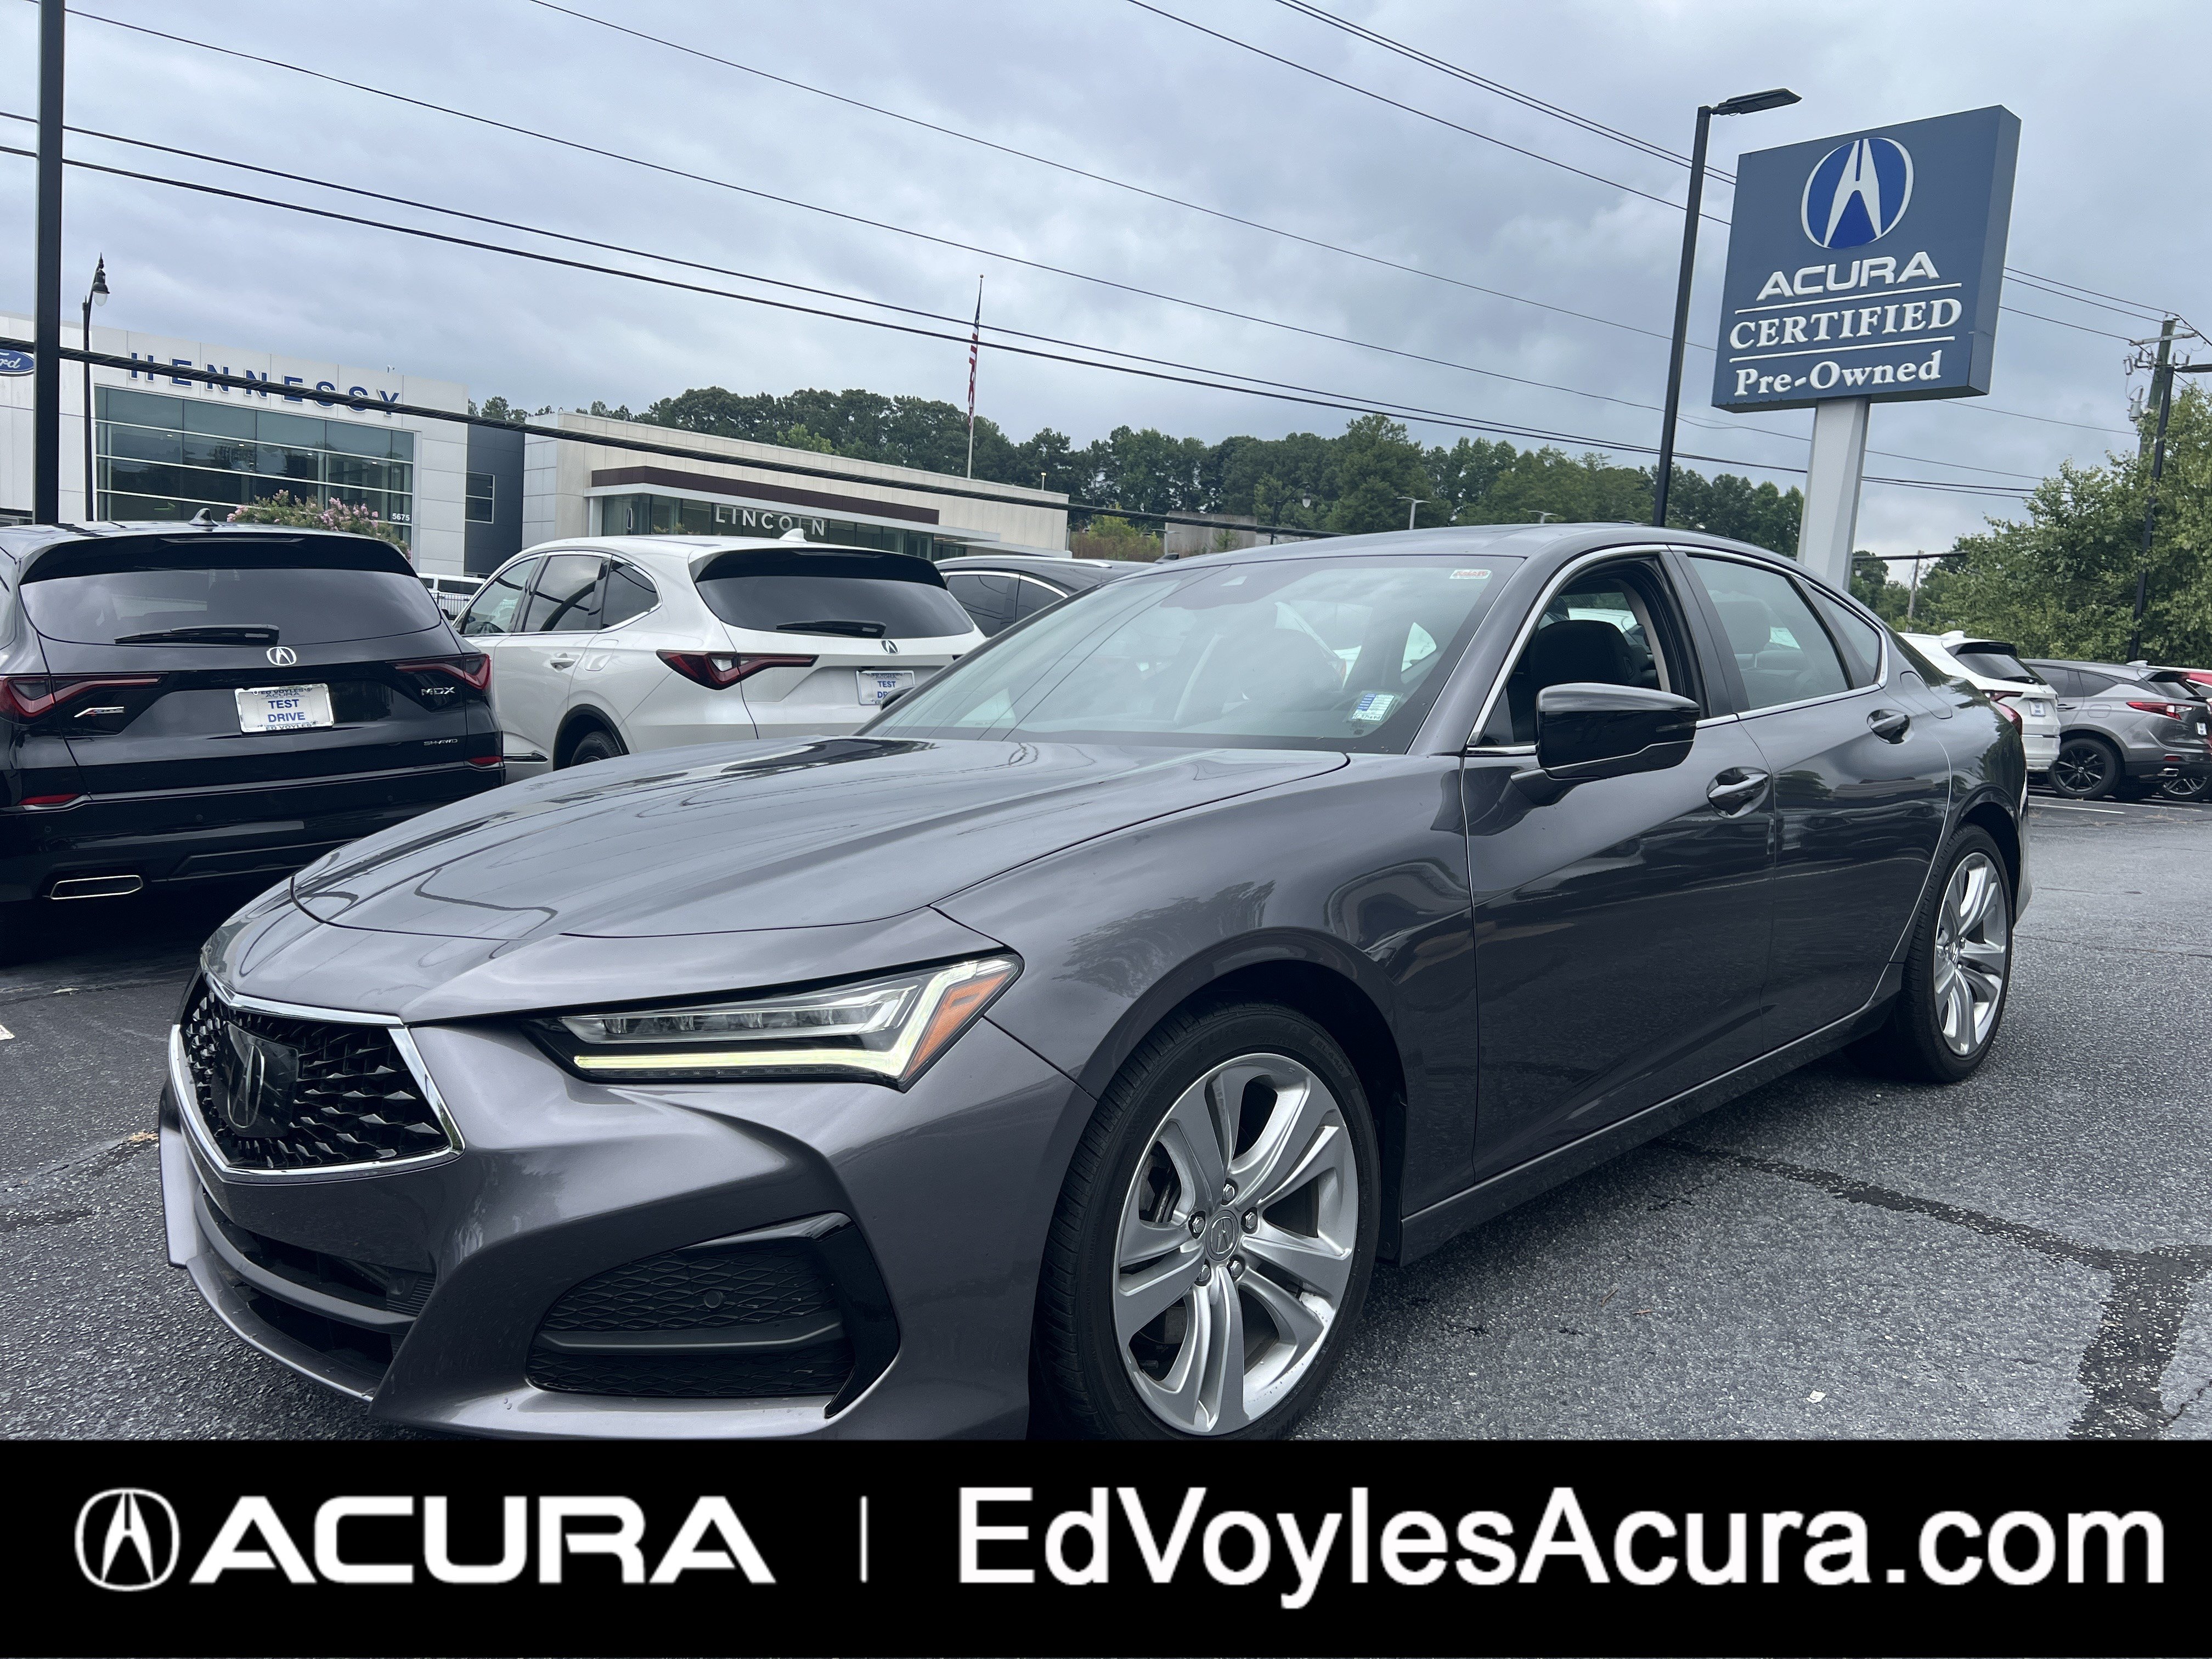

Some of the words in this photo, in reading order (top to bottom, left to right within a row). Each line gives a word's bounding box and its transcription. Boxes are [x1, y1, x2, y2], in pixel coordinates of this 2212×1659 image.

[1756, 251, 1940, 301] ACURA
[1729, 298, 1963, 349] CERTIFIED
[129, 352, 400, 416] HENNESSY
[1734, 349, 1943, 397] Pre-Owned
[392, 512, 410, 521] 5675
[268, 699, 300, 709] TEST
[421, 687, 455, 696] MDX
[268, 712, 306, 723] DRIVE
